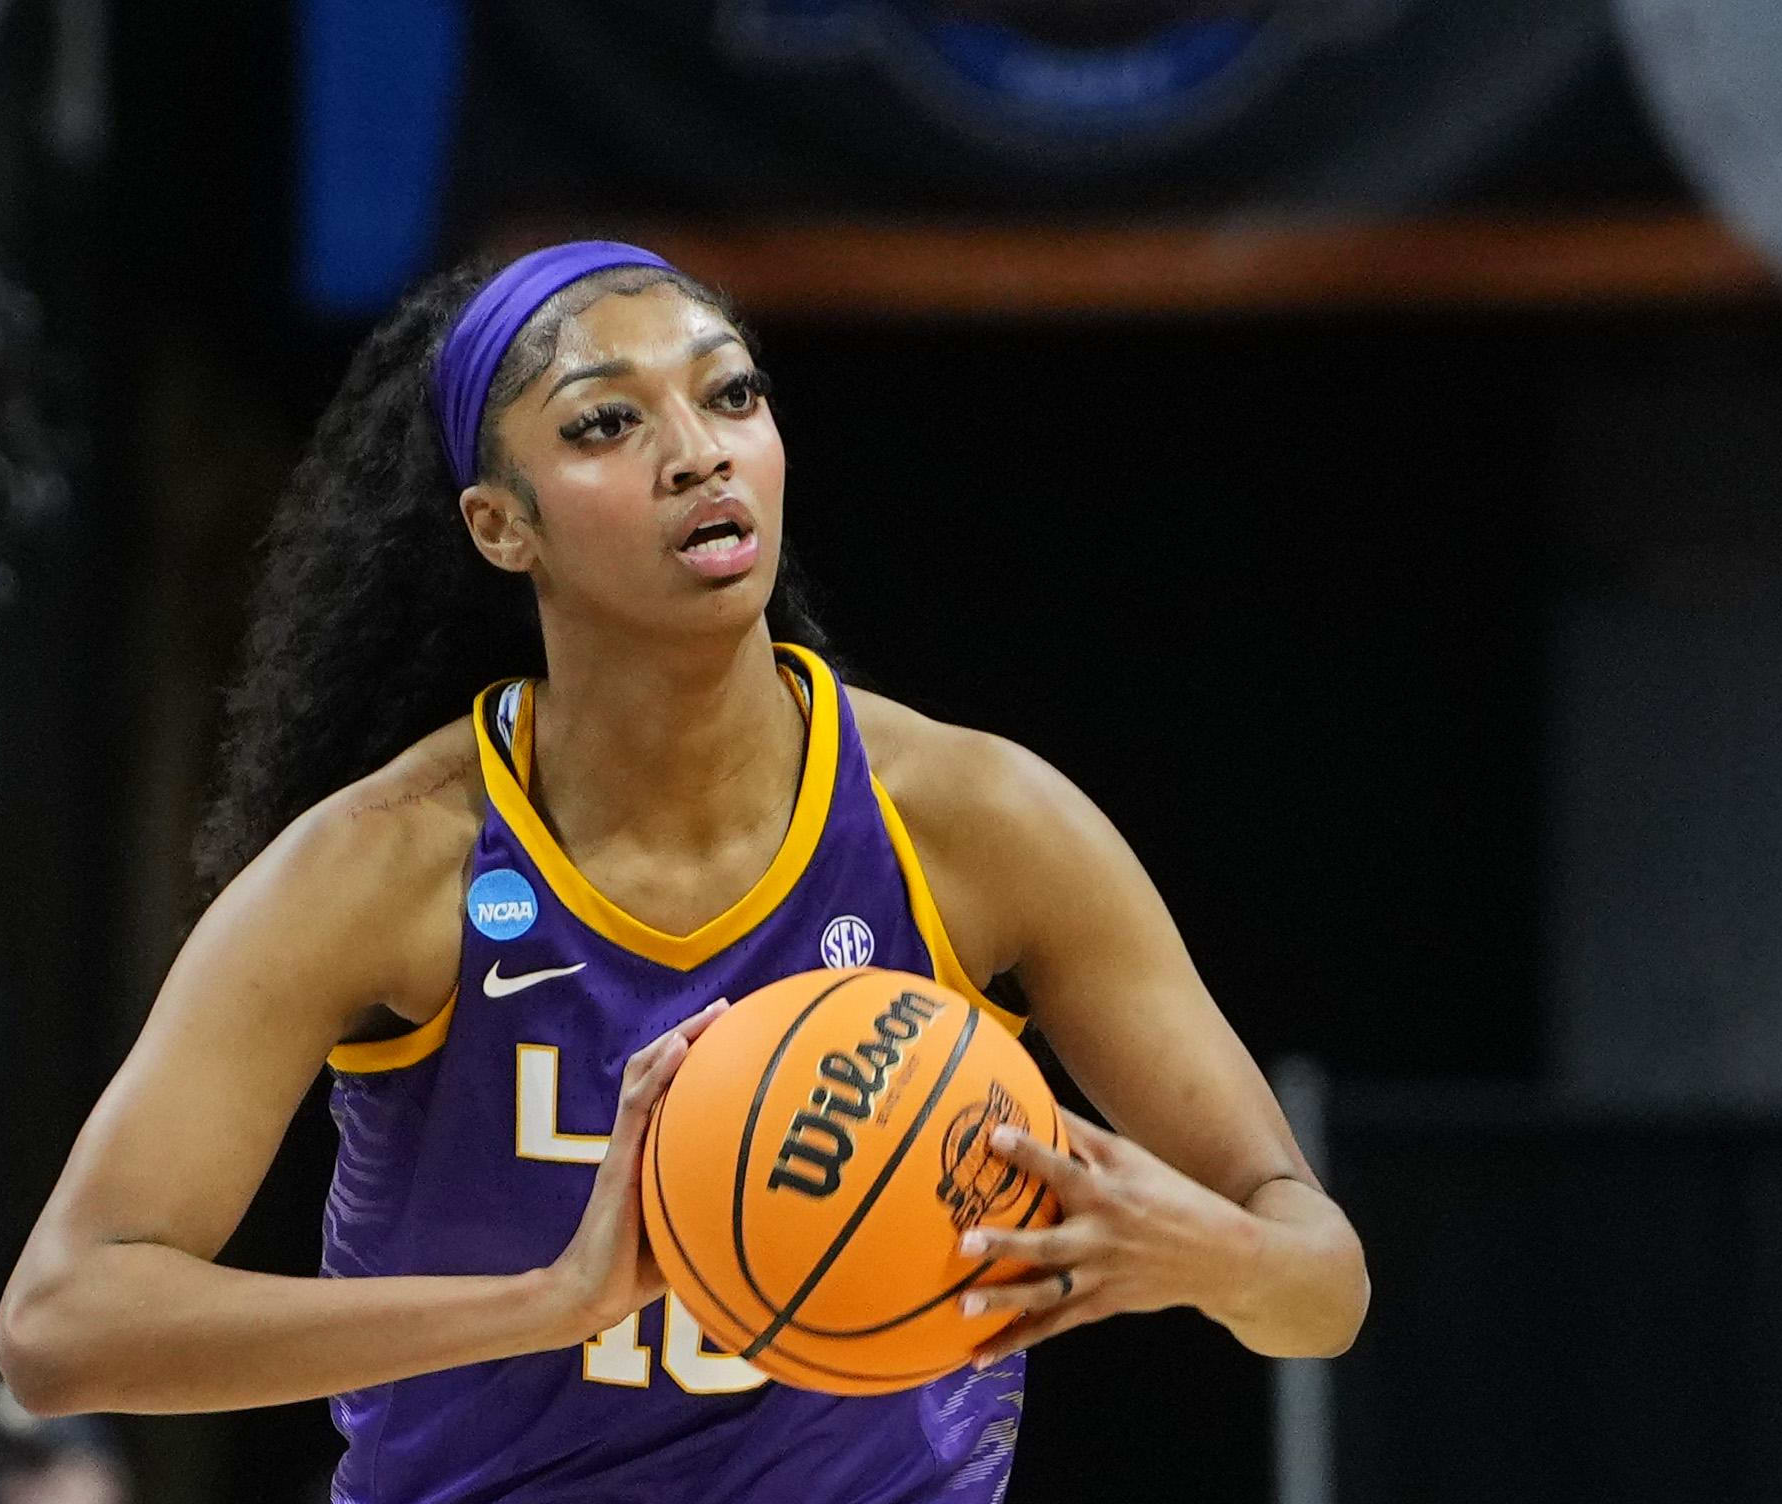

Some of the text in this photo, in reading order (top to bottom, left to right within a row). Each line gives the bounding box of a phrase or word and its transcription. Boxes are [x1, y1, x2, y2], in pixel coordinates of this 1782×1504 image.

[477, 900, 534, 924] NCAA
[825, 920, 871, 968] SEC
[767, 990, 946, 1198] Wilson
